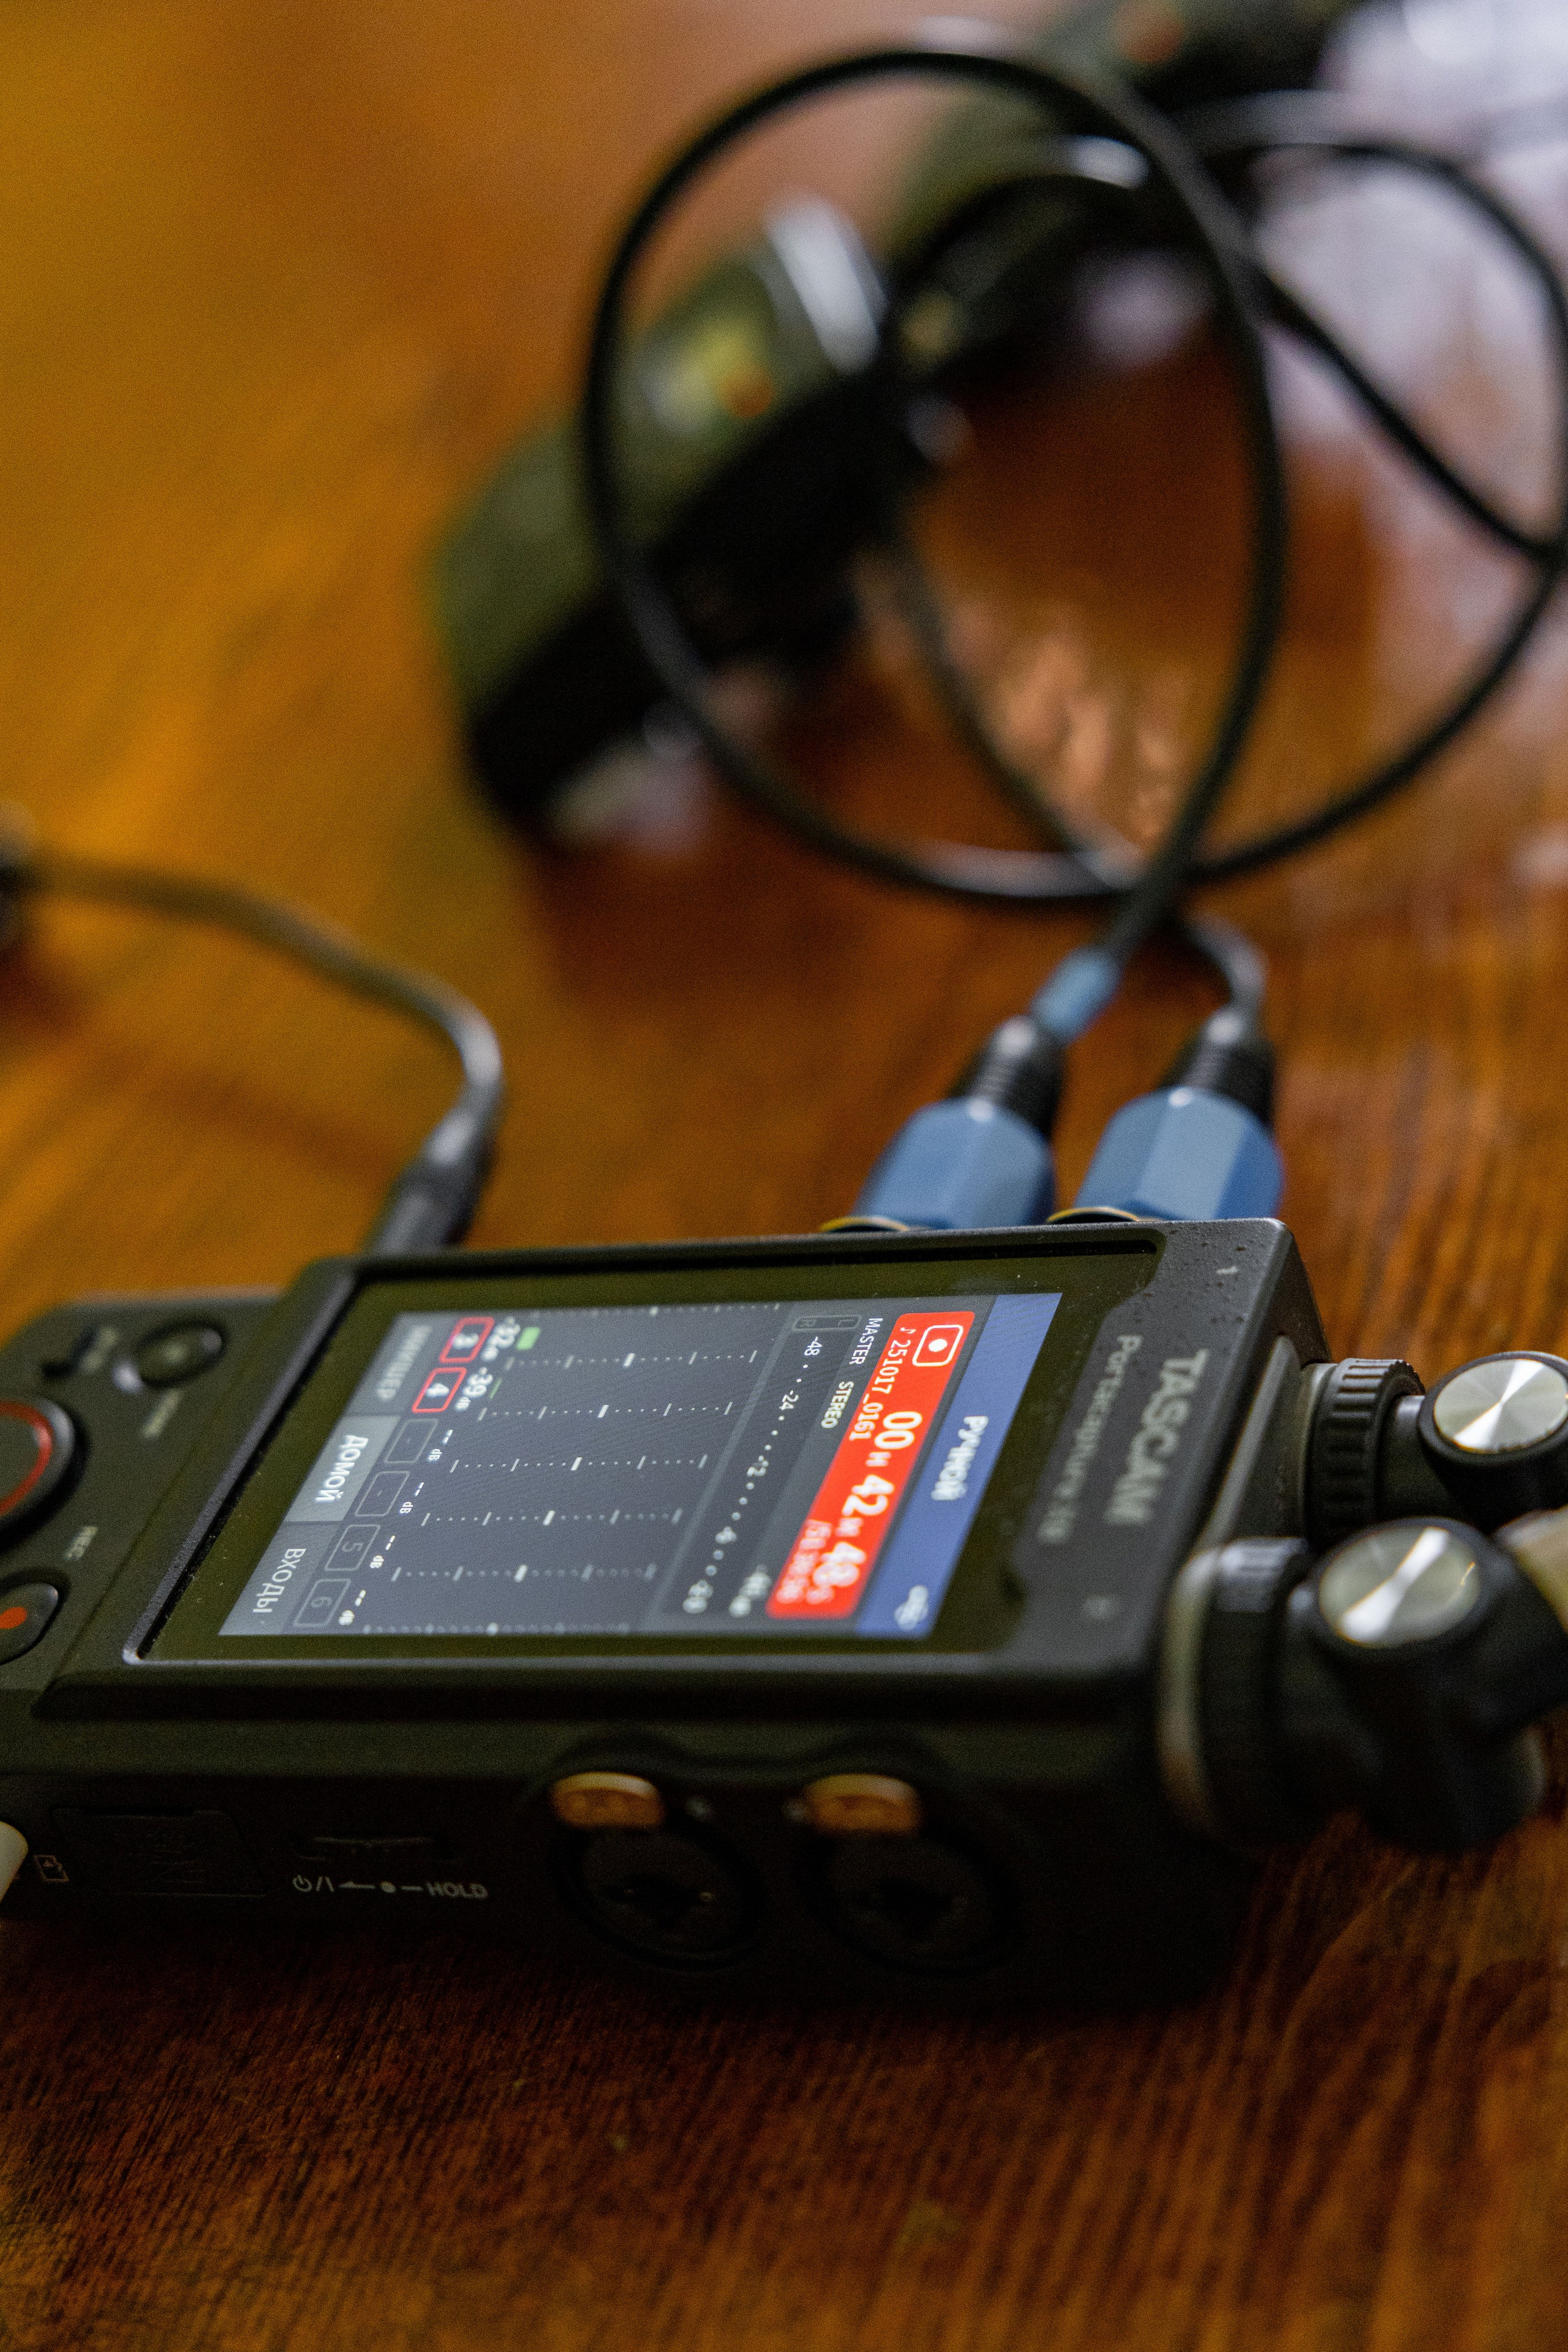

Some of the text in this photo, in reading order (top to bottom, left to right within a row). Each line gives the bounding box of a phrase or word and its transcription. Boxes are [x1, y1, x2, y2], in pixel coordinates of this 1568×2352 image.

[804, 1336, 823, 1357] -48
[820, 1317, 883, 1429] MASTER STEREO
[849, 1339, 911, 1442] 251017_0161
[778, 1390, 799, 1410] -24
[1106, 1349, 1209, 1526] TASCAM
[315, 1434, 369, 1502] ДОМОЙ
[341, 1542, 364, 1553] 5
[252, 1548, 306, 1613] ВХОДЫ
[309, 1596, 333, 1608] 6
[425, 1881, 488, 1899] HOLD
